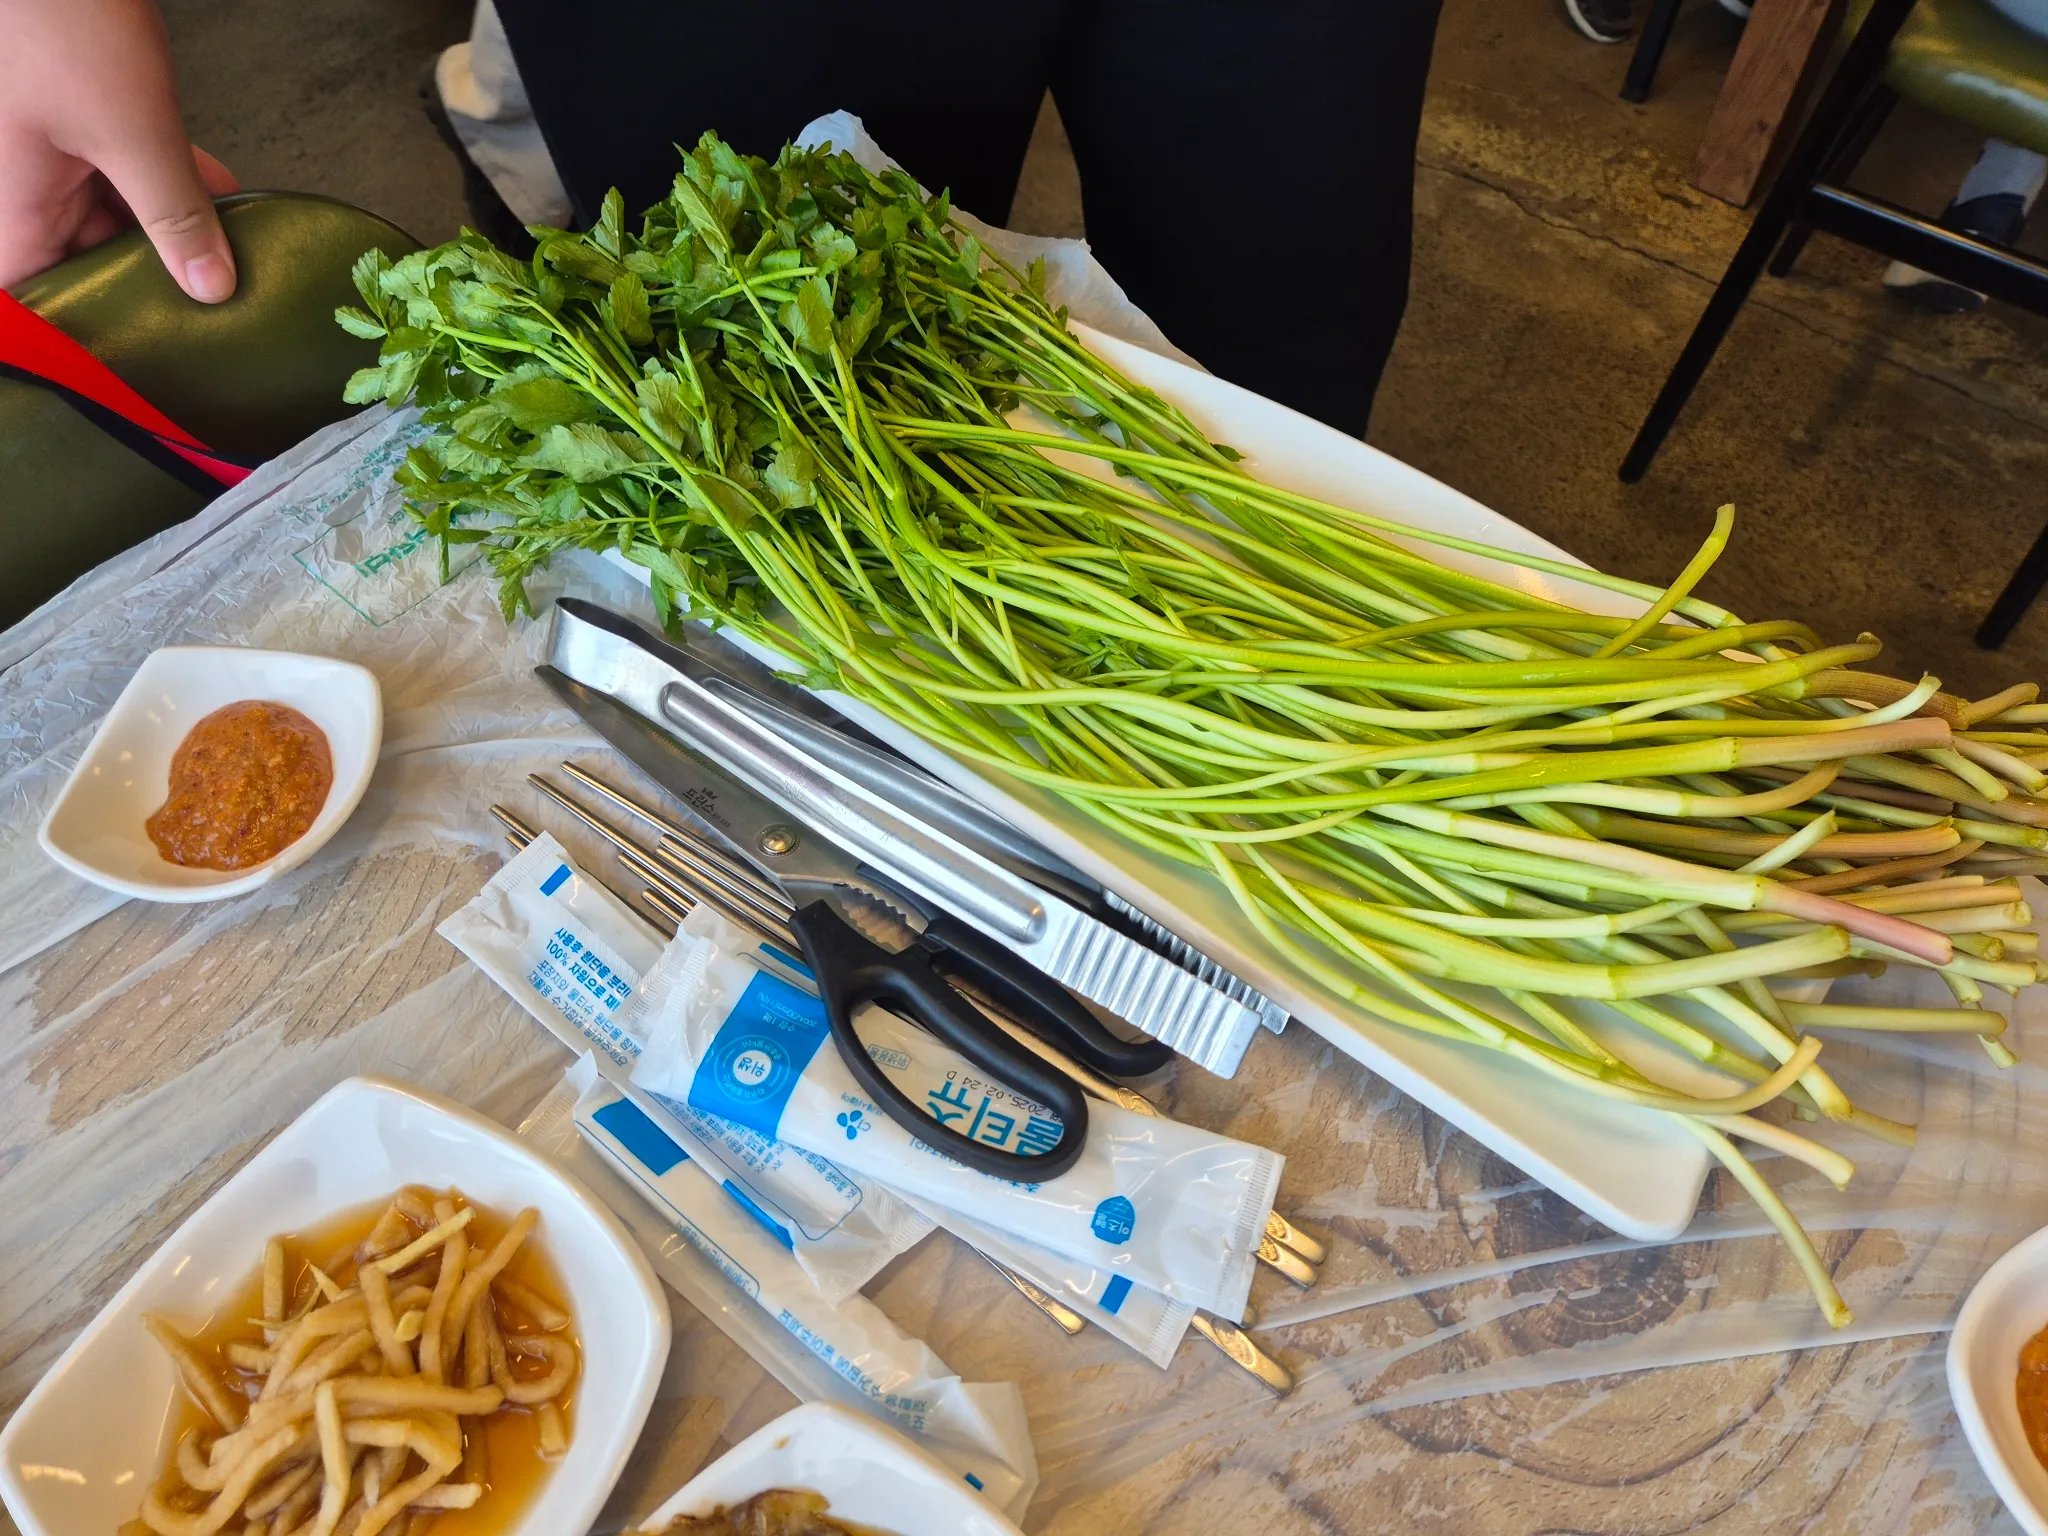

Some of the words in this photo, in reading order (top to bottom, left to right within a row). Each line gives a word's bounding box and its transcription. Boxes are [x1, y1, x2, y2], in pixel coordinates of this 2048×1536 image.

[681, 785, 717, 817] 프린스
[543, 939, 571, 966] 100%
[567, 961, 606, 999] 자원으로
[602, 994, 620, 1012] 재
[553, 926, 583, 954] 사용후
[579, 949, 610, 979] 원단을
[524, 970, 553, 998] 재활용
[549, 994, 586, 1029] 수거함에
[582, 1025, 629, 1068] 넣어주세요
[535, 958, 570, 992] 포장지와
[566, 987, 596, 1016] 물티슈
[592, 1012, 623, 1041] 원단을
[619, 1036, 642, 1058] 함께
[737, 1056, 766, 1078] 위생
[925, 1079, 1064, 1159] 물티슈
[962, 1075, 1046, 1117] 2025.02.24
[855, 1118, 871, 1132] CJ
[1093, 1211, 1132, 1235] 이츠웰
[833, 1354, 884, 1400] 수거함에
